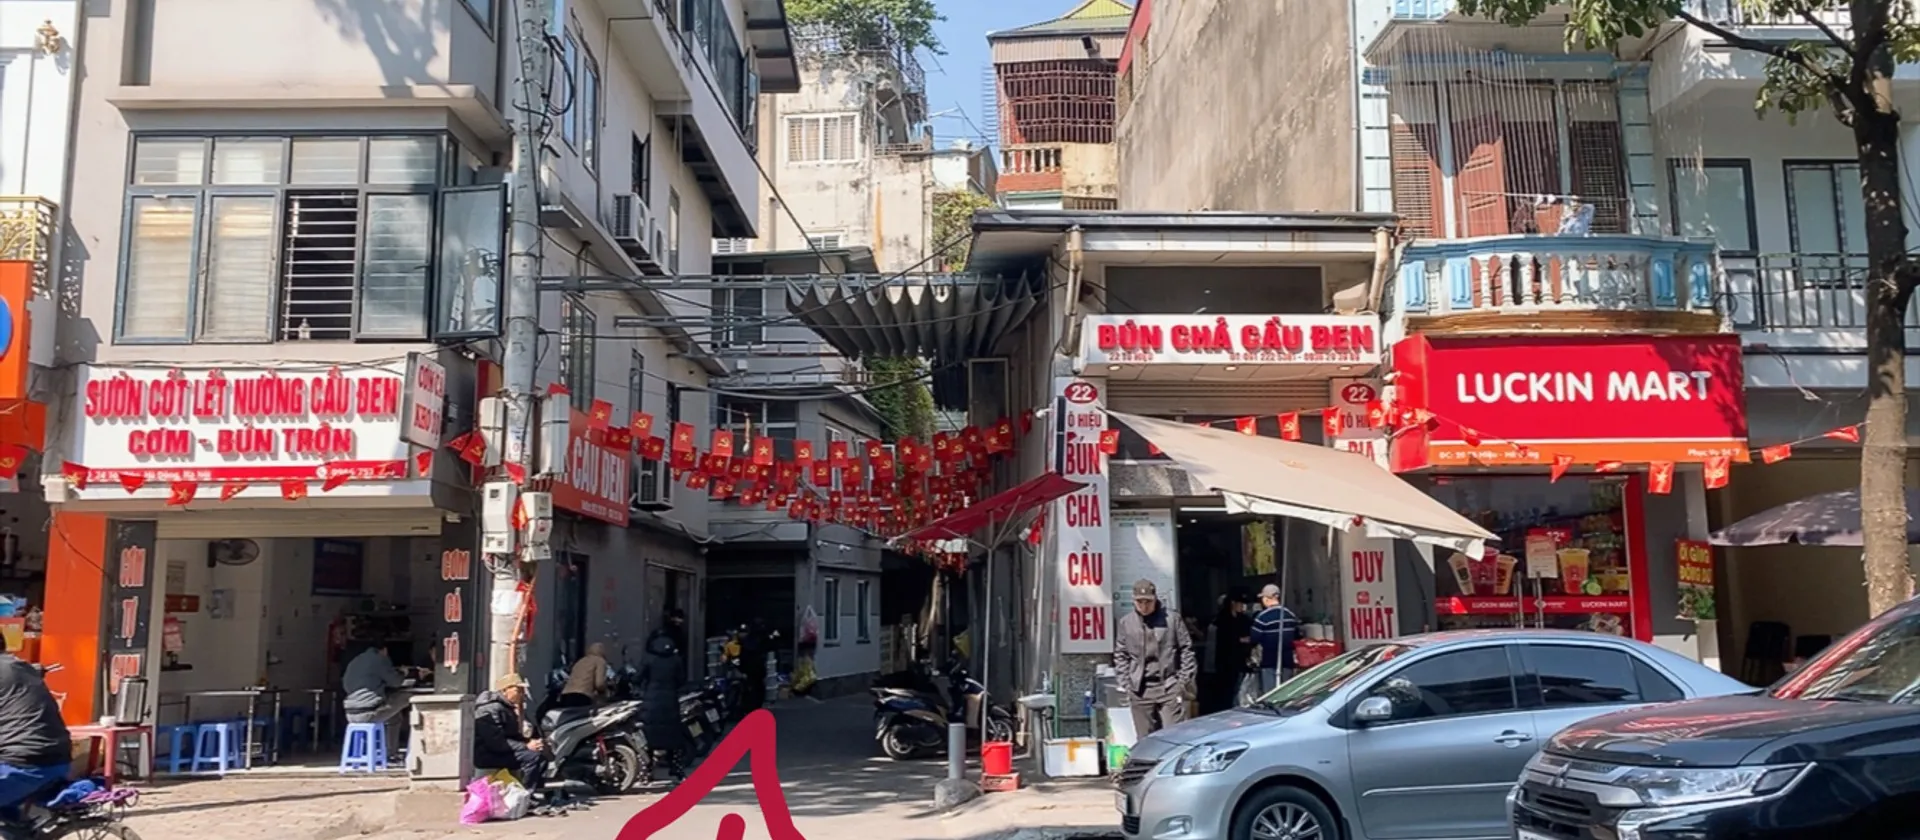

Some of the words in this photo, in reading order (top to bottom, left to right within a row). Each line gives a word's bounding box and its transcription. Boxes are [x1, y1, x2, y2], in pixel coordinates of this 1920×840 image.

[1099, 320, 1161, 350] BÚN
[1171, 317, 1232, 351] CHẢ
[1241, 317, 1302, 350] CẦU
[1311, 325, 1373, 350] ĐEN
[1260, 352, 1274, 361] 222
[84, 371, 144, 417] SƯỜN
[148, 368, 188, 416] CỐT
[193, 368, 226, 416] LẾT
[234, 368, 303, 415] NƯỚNG
[311, 366, 350, 414] CẦU
[356, 377, 399, 415] ĐEN
[1071, 385, 1092, 401] 22
[1349, 386, 1369, 402] 22
[1457, 371, 1593, 403] LUCKIN
[1607, 371, 1711, 401] MART
[1078, 411, 1101, 430] HIỆU
[128, 428, 191, 454] CƠM
[217, 422, 272, 453] BÚN
[282, 422, 352, 457] TRỘN
[1066, 436, 1101, 475] BÚN
[1066, 484, 1101, 528] CHẢ
[1067, 541, 1103, 586] CẦU
[1352, 551, 1384, 583] DUY
[1069, 606, 1105, 640] ĐEN
[1350, 595, 1394, 640] NHẤT
